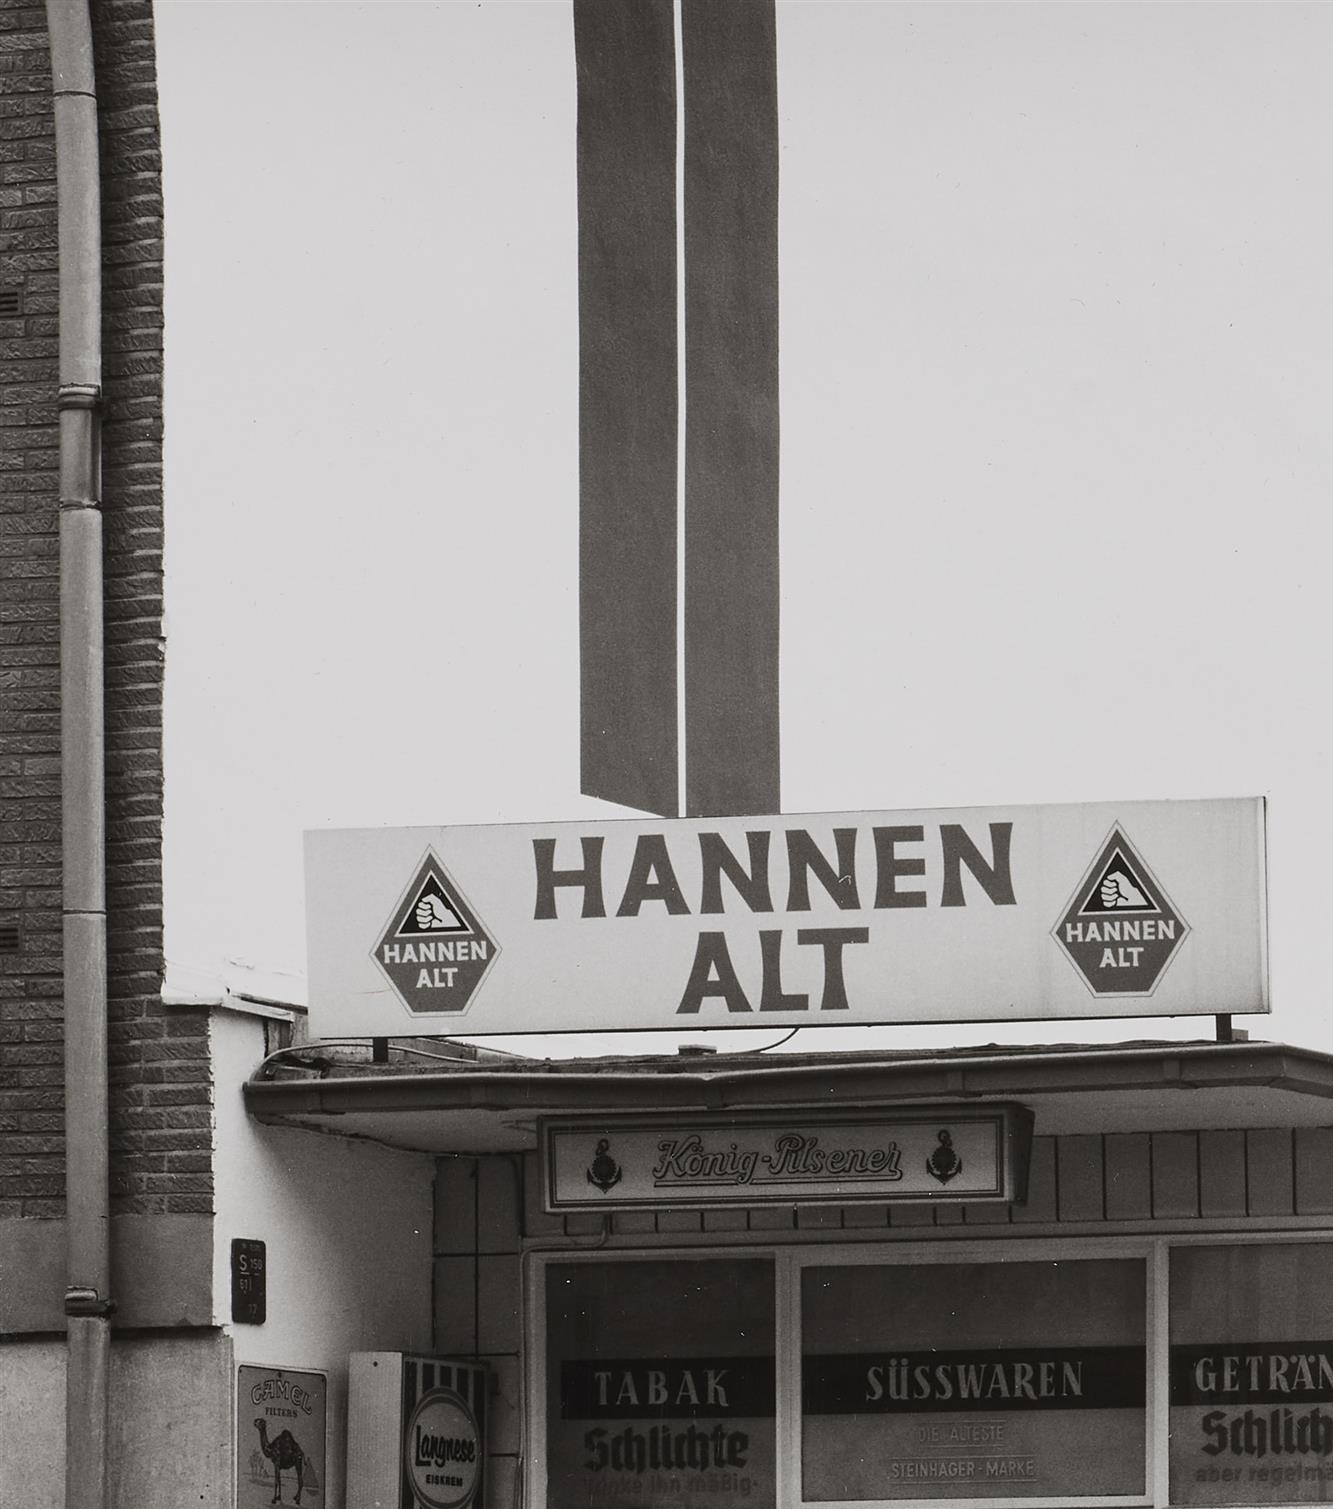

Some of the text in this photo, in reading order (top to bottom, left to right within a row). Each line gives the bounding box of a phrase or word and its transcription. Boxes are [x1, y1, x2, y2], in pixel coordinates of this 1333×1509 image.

[532, 822, 1017, 920] HANNEN
[1065, 919, 1176, 942] HANNEN
[383, 940, 488, 964] HANNEN
[675, 927, 870, 1014] ALT
[1099, 946, 1144, 968] ALT
[415, 967, 459, 989] ALT
[251, 1378, 312, 1416] CAMEL
[594, 1368, 731, 1407] TABAK
[865, 1358, 1083, 1400] SÜSSWAREN
[415, 1424, 476, 1468] Langnese
[583, 1423, 749, 1474] Schlichte
[425, 1474, 463, 1487] EISKREM
